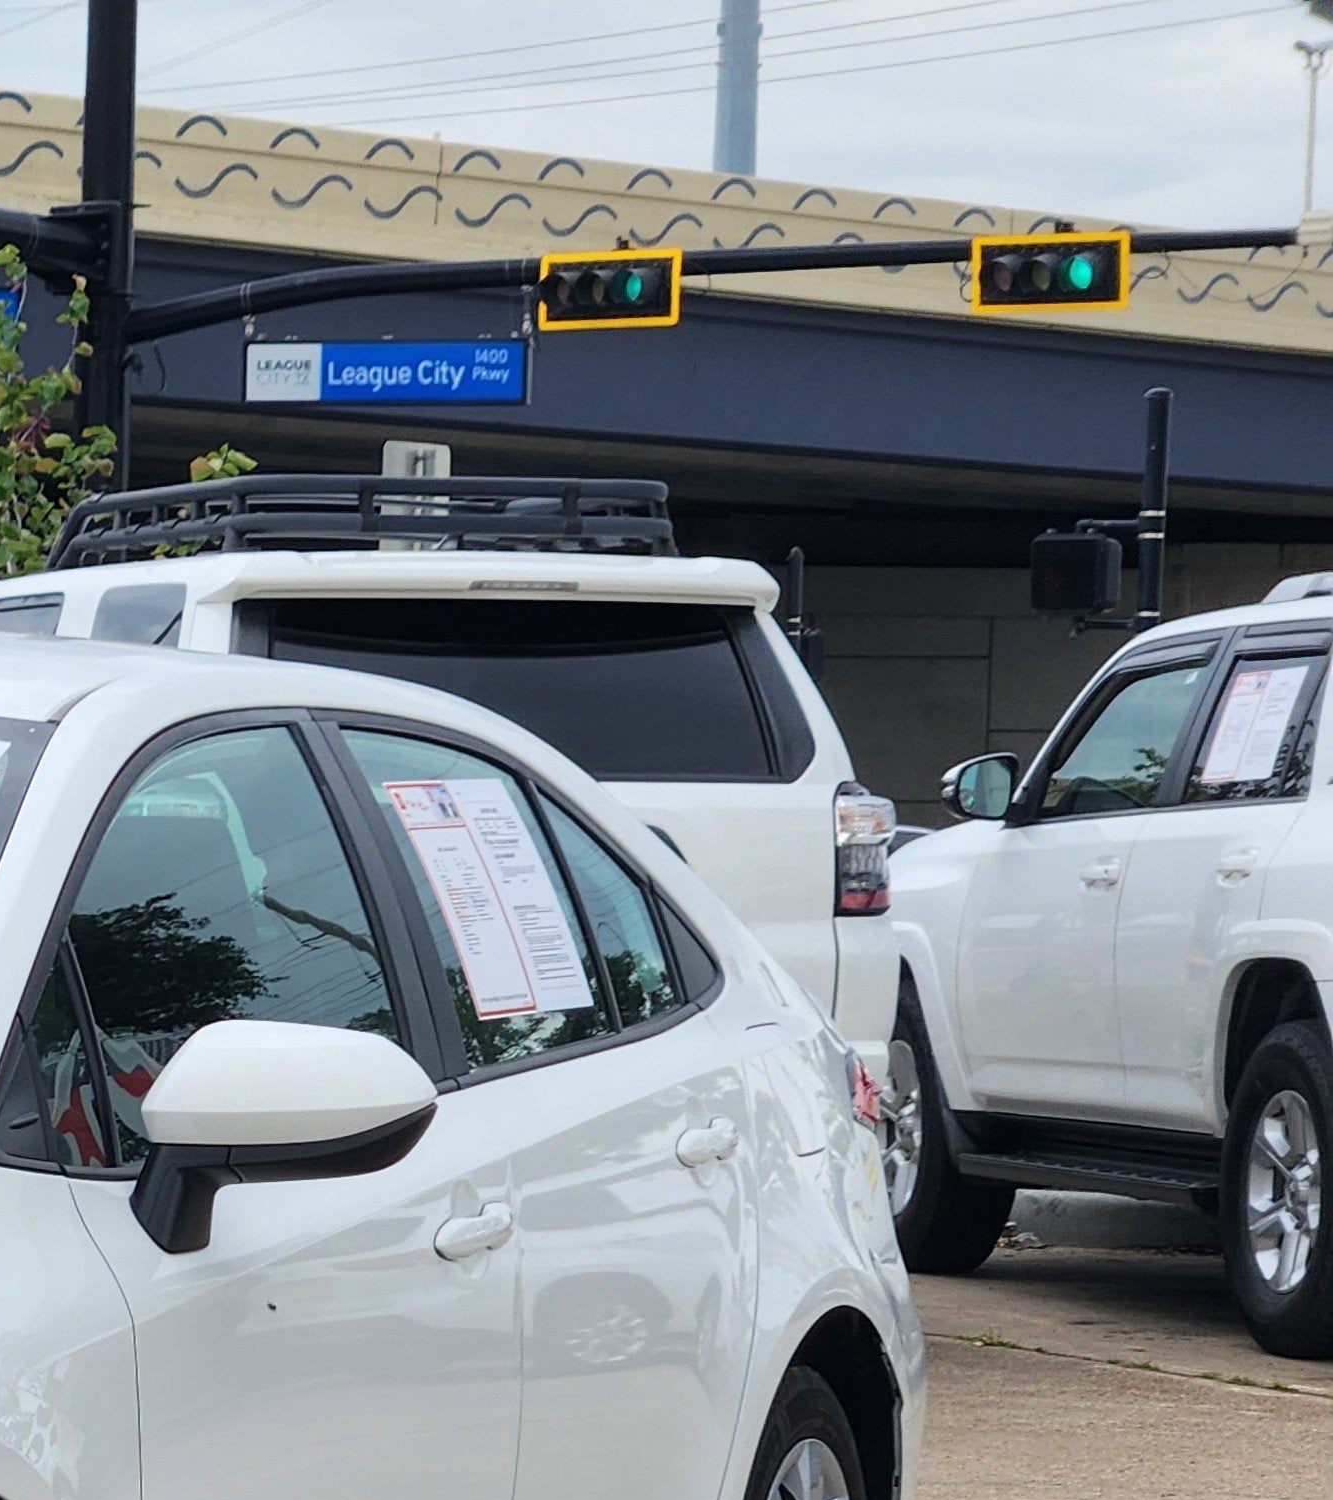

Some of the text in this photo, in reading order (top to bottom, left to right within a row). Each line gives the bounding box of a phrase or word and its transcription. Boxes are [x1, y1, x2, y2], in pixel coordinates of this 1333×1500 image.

[474, 348, 509, 364] 1400
[256, 359, 312, 371] LEAGUE
[327, 359, 466, 393] League City
[471, 366, 510, 383] Pkwy
